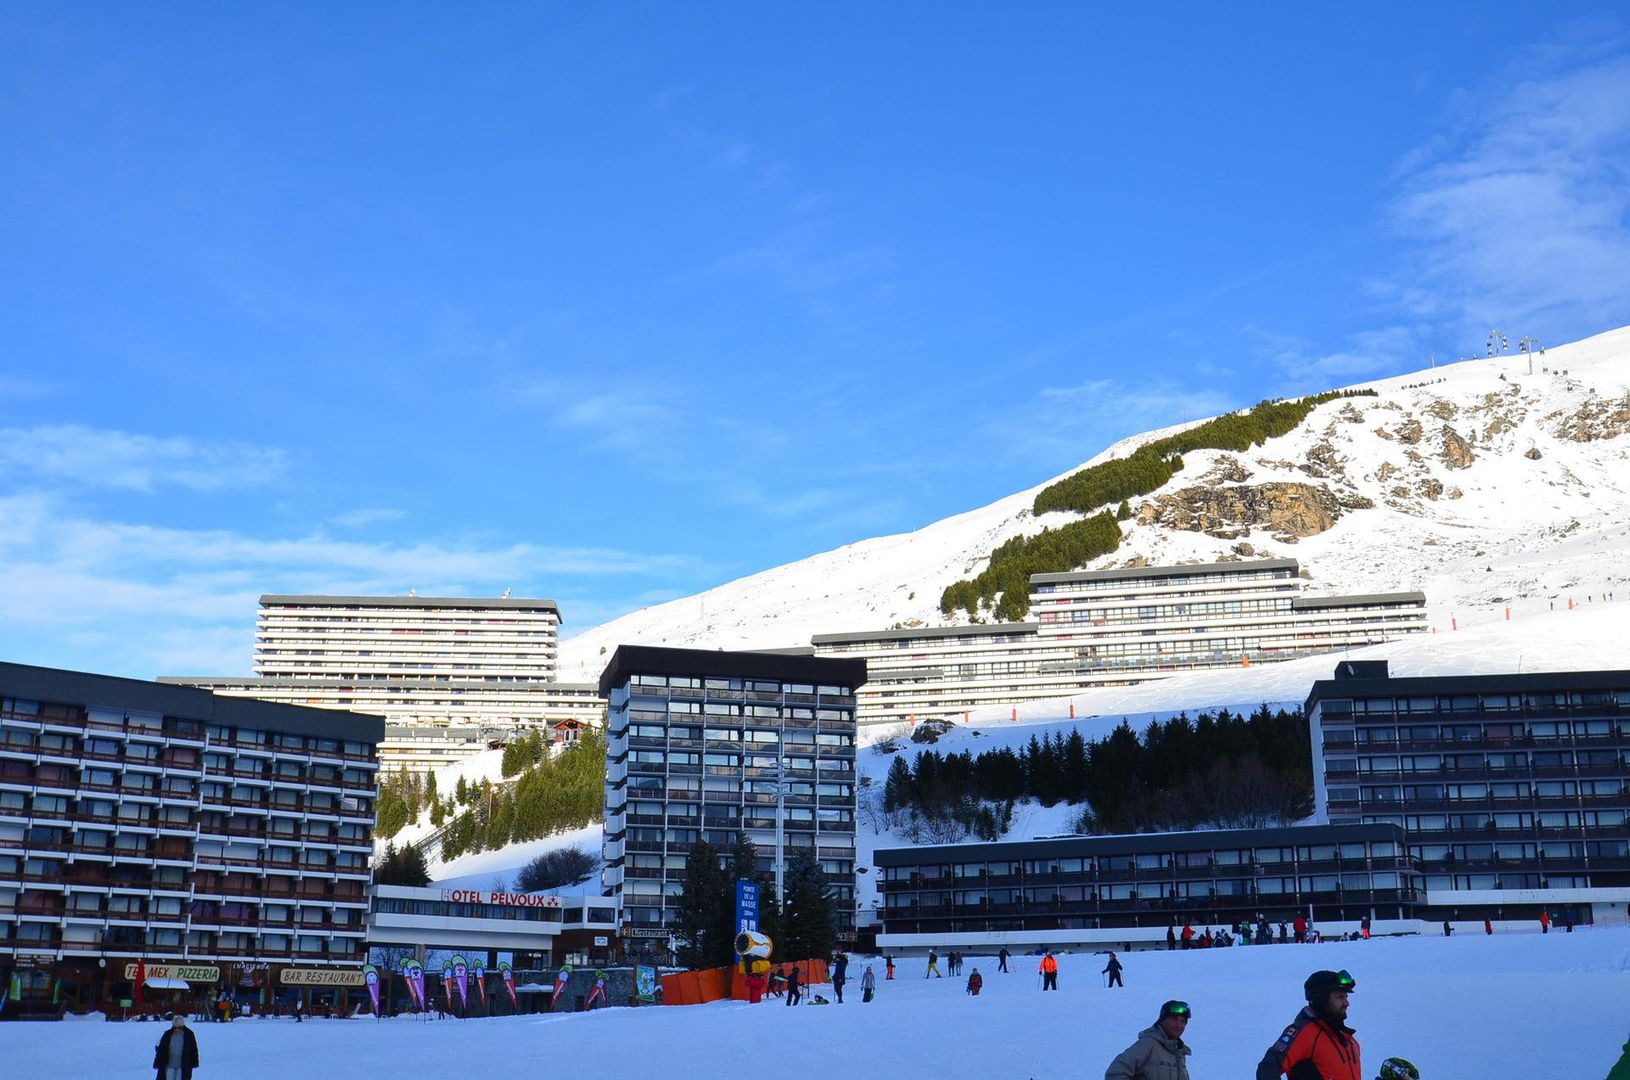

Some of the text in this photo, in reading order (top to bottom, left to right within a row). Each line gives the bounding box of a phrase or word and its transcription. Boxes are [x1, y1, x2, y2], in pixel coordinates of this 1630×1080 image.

[441, 889, 544, 907] HOTEL PELVOUX
[127, 966, 219, 980] TE MEX PIZZERIA
[284, 971, 363, 984] BAR RESTAURANT
